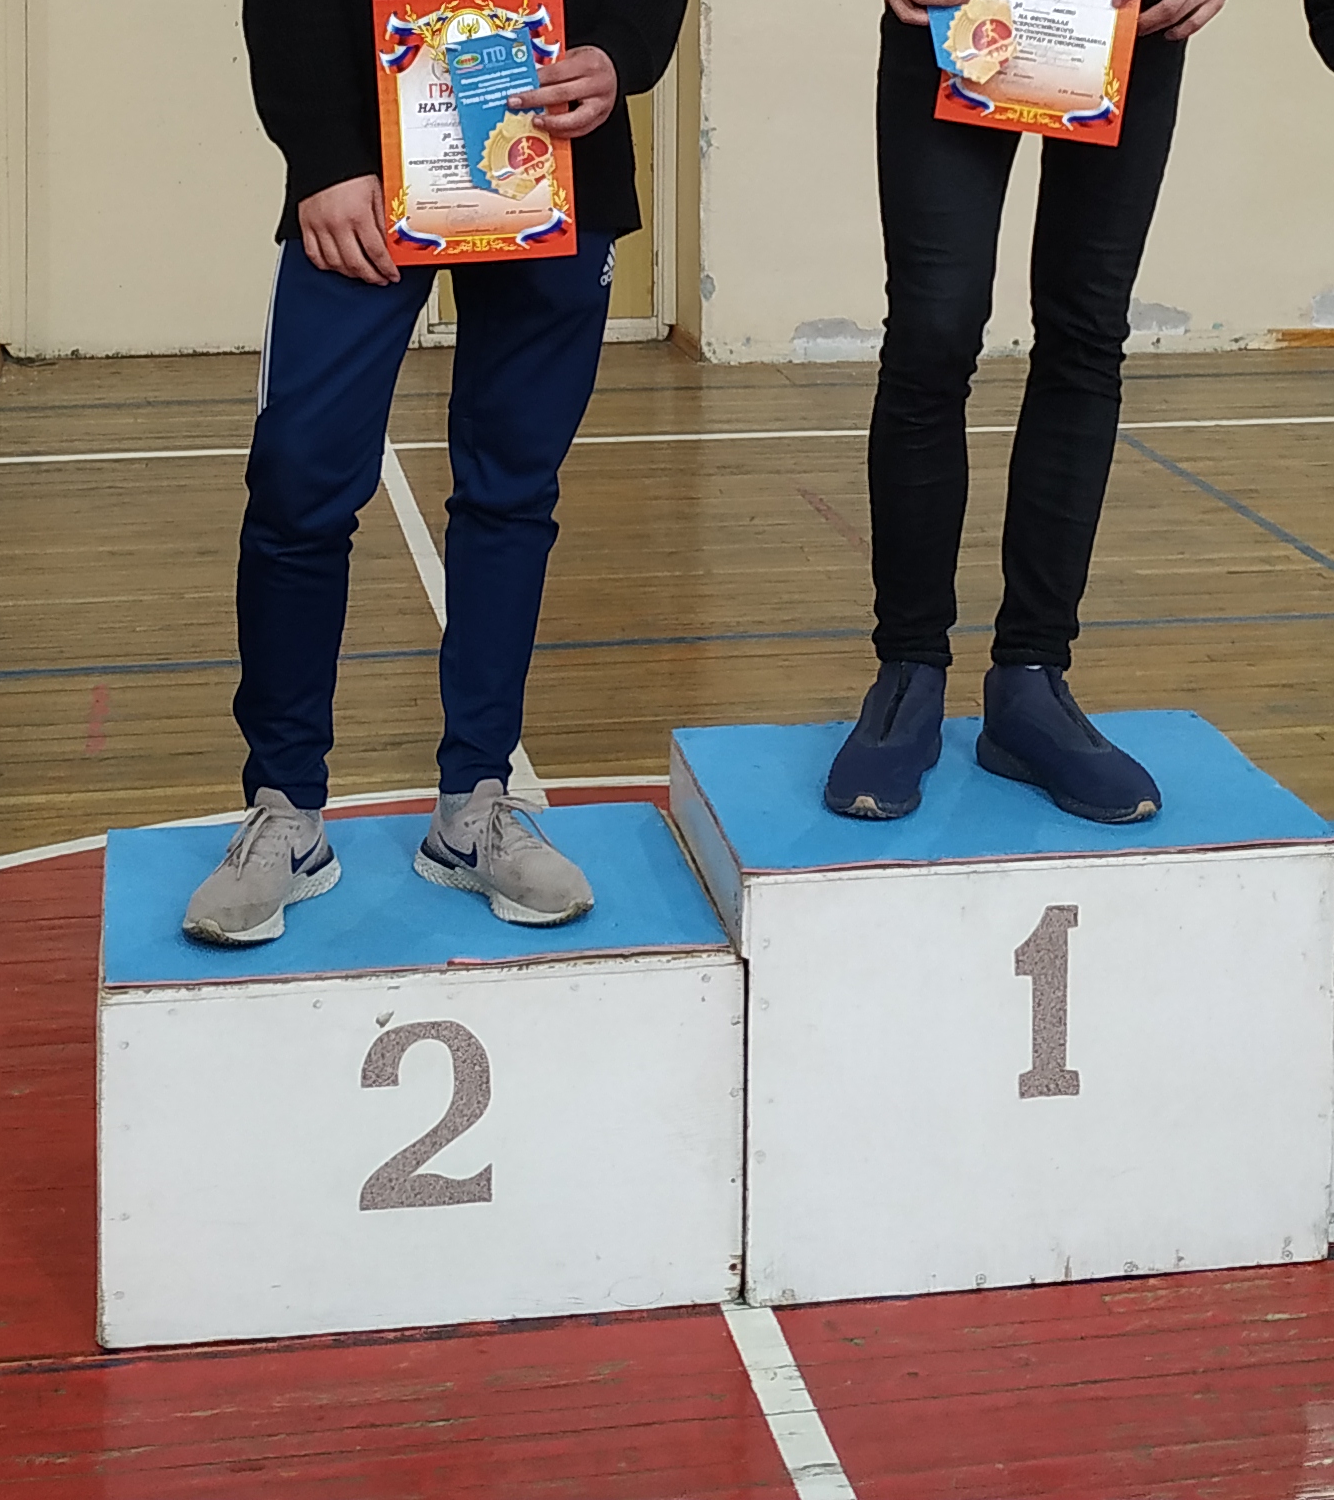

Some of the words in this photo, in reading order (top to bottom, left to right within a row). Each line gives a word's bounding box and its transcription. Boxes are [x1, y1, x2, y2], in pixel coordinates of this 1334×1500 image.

[524, 160, 545, 176] ГТО
[1014, 905, 1080, 1099] 1
[359, 1020, 492, 1211] 2
